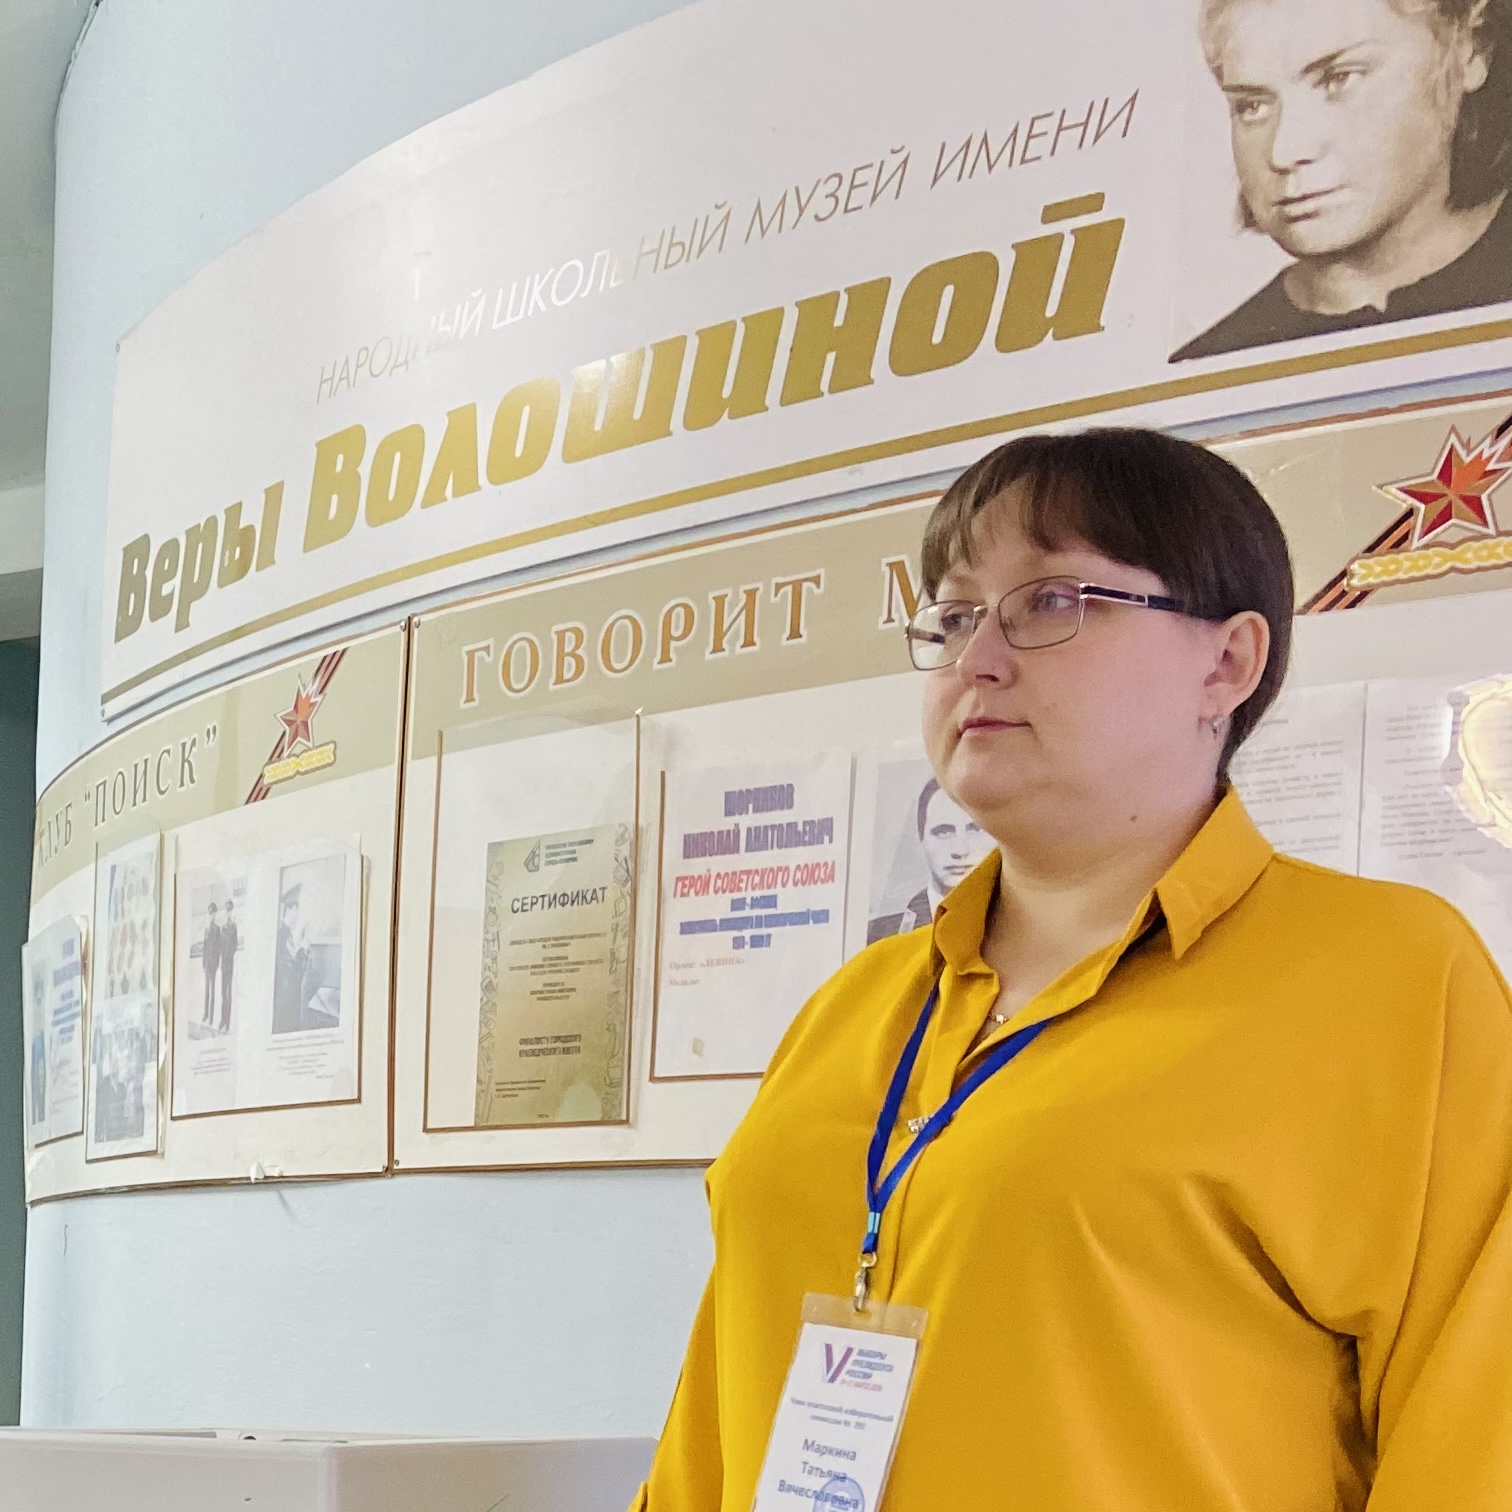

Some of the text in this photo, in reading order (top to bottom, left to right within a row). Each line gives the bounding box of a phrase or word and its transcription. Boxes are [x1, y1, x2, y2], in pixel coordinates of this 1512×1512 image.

[744, 145, 911, 244] МУЗЕЙ
[930, 87, 1139, 191] ИМЕНИ
[114, 192, 1125, 645] Веры Волошиной
[462, 573, 823, 705] ГОВОРИТ
[682, 823, 741, 860] НИКОЛАЙ
[672, 860, 836, 899] ГЕРОЙ СОВЕТСКОГО СОЮЗА
[510, 886, 608, 914] СЕРТИФИКАТ
[802, 1438, 857, 1461] Маркина
[801, 1461, 848, 1482] Татьяна
